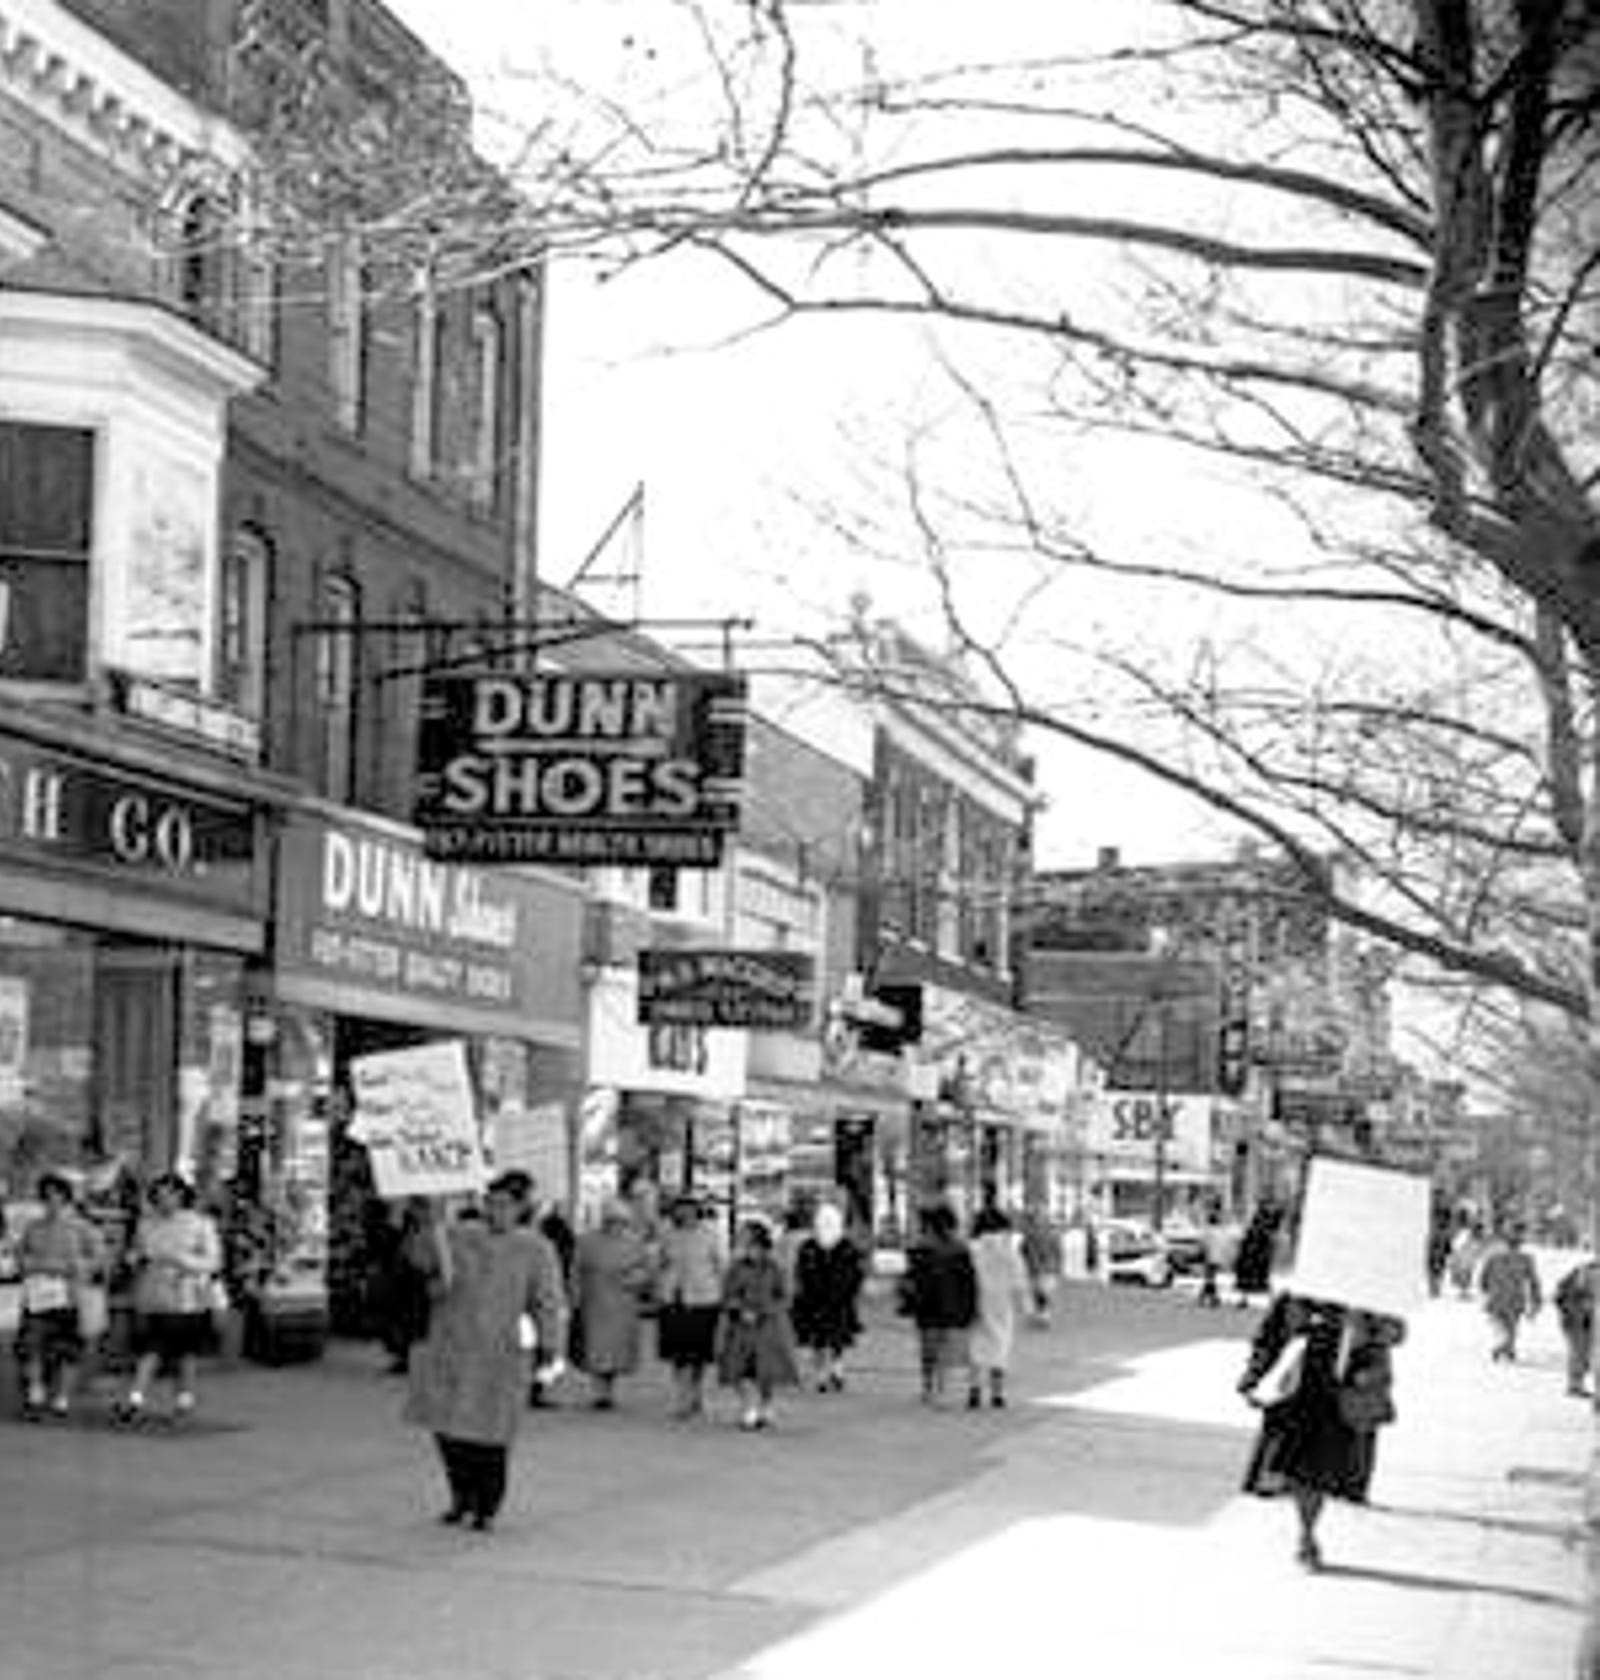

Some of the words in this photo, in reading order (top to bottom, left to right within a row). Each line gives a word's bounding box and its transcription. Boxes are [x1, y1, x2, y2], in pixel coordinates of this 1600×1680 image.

[473, 681, 678, 735] DUNN
[444, 754, 700, 815] SHOES
[109, 794, 208, 877] CO.
[323, 831, 447, 933] DUNN
